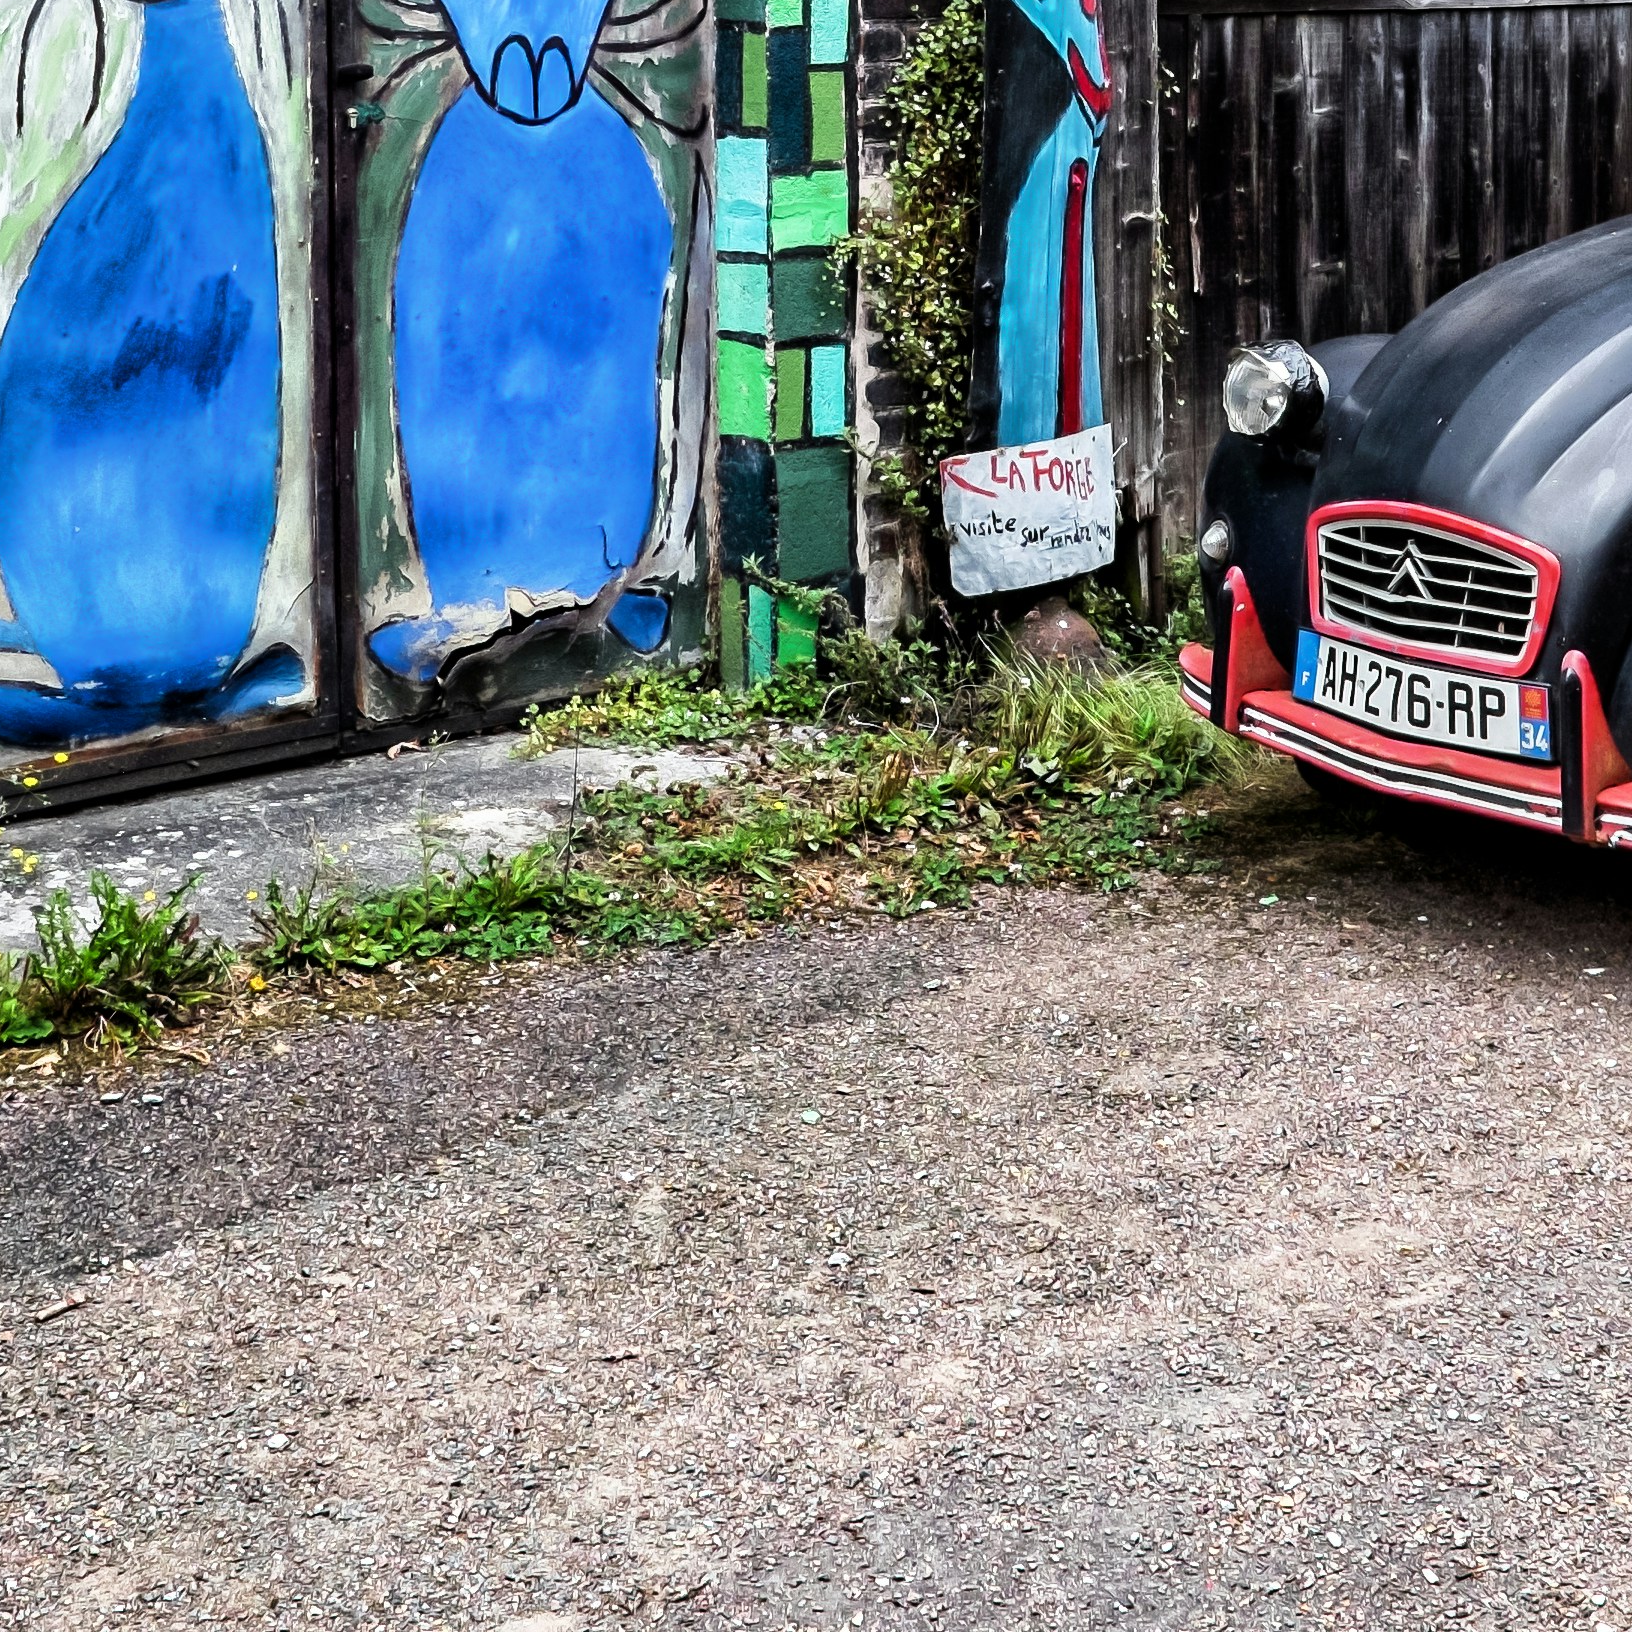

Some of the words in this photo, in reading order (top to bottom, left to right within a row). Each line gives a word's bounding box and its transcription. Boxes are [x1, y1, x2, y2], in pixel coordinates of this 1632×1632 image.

[990, 454, 1026, 493] LA
[959, 510, 1017, 537] visite
[1020, 525, 1050, 548] sur
[1301, 671, 1311, 687] F
[1520, 721, 1548, 752] 34
